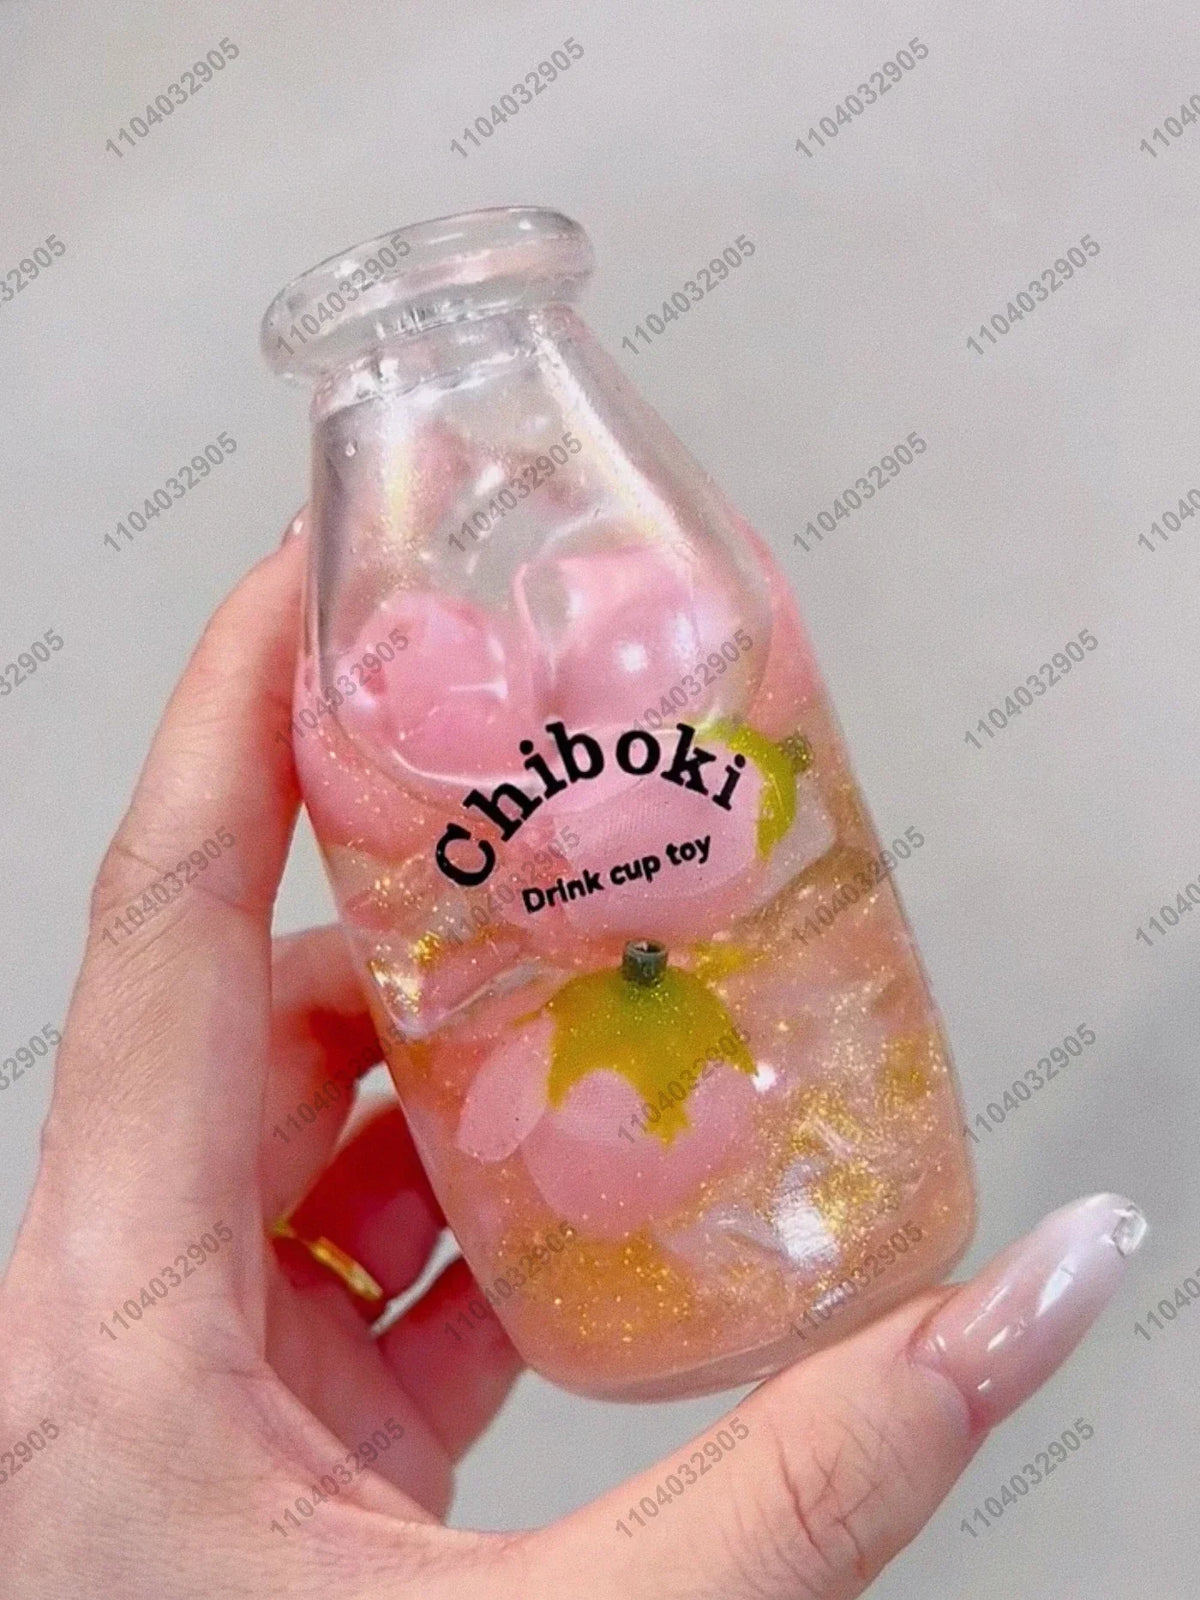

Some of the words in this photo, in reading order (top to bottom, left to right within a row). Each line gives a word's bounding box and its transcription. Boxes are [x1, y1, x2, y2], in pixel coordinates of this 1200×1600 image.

[436, 722, 746, 887] Chiboki
[522, 869, 604, 913] Drink
[610, 854, 661, 886] cup
[666, 835, 711, 865] toy
